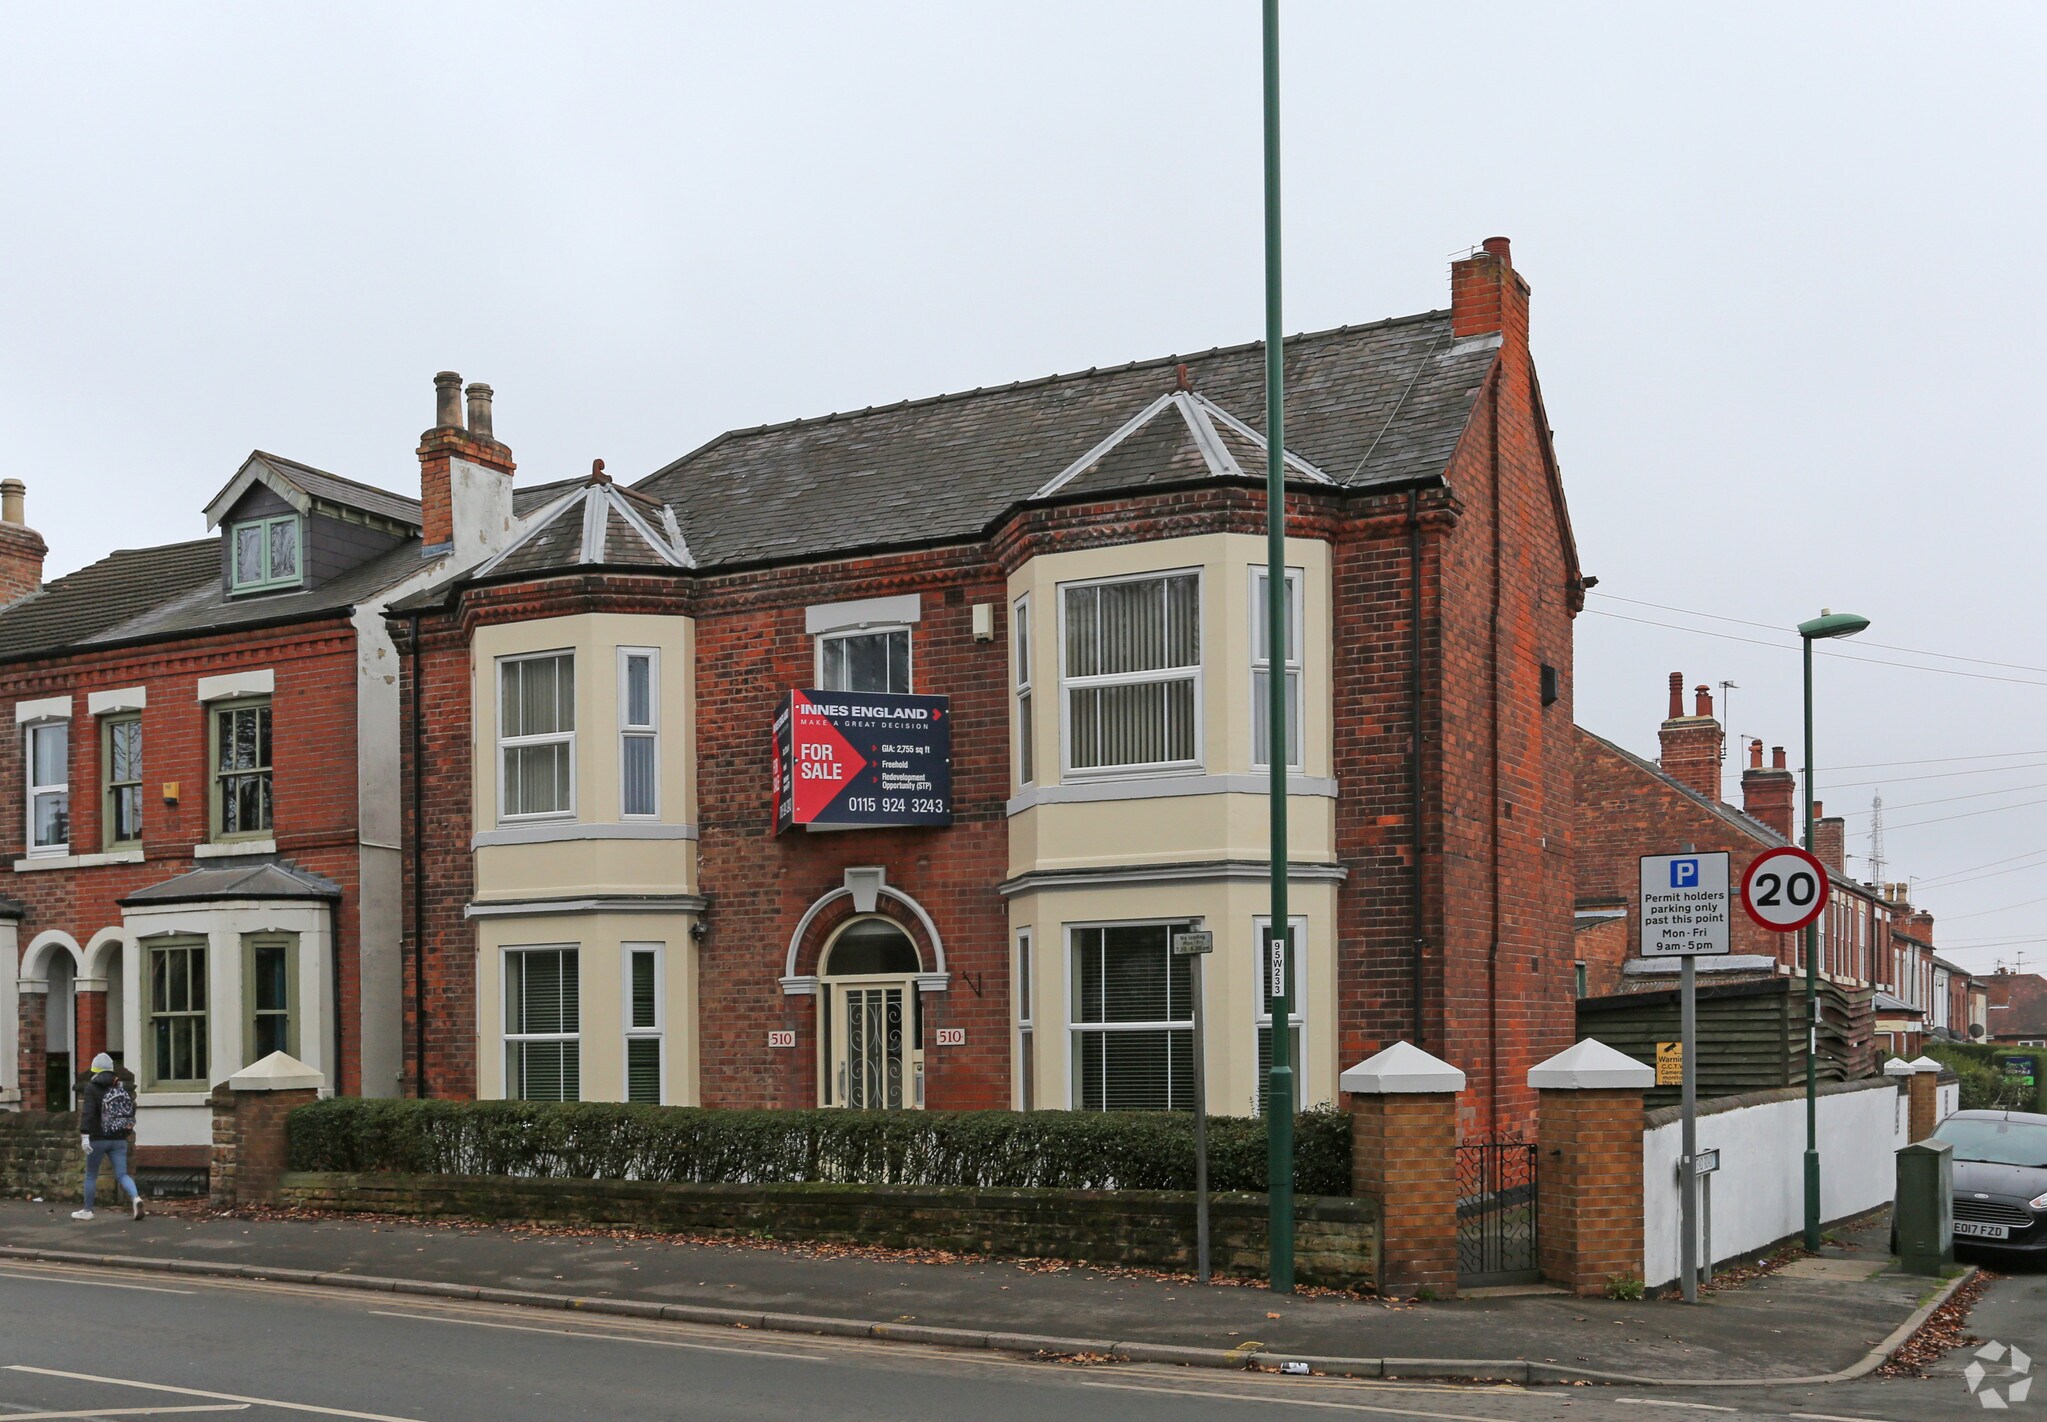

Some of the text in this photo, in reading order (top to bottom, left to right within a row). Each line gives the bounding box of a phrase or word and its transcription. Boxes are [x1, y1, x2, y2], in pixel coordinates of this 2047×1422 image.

[800, 704, 928, 720] INNES ENGLAND
[844, 720, 876, 728] GREAT
[881, 722, 929, 730] DECISION
[801, 743, 833, 761] FOR
[881, 744, 931, 756] GIA: 2,755 sq ft
[881, 760, 909, 769] Freehold
[801, 762, 843, 780] SALE
[881, 772, 926, 783] Redevelopment
[881, 781, 932, 792] Opportunity (STP)
[848, 797, 943, 813] 0115 924 3243
[1677, 862, 1695, 885] P
[1755, 871, 1816, 907] 20
[1645, 891, 1725, 903] Permit holders
[1650, 902, 1718, 915] parking only
[1645, 913, 1724, 926] past this point
[1662, 928, 1685, 938] Mon
[1692, 927, 1707, 937] Fri
[771, 1033, 792, 1045] 510
[939, 1031, 961, 1043] 510
[1980, 1225, 2002, 1237] FZD
